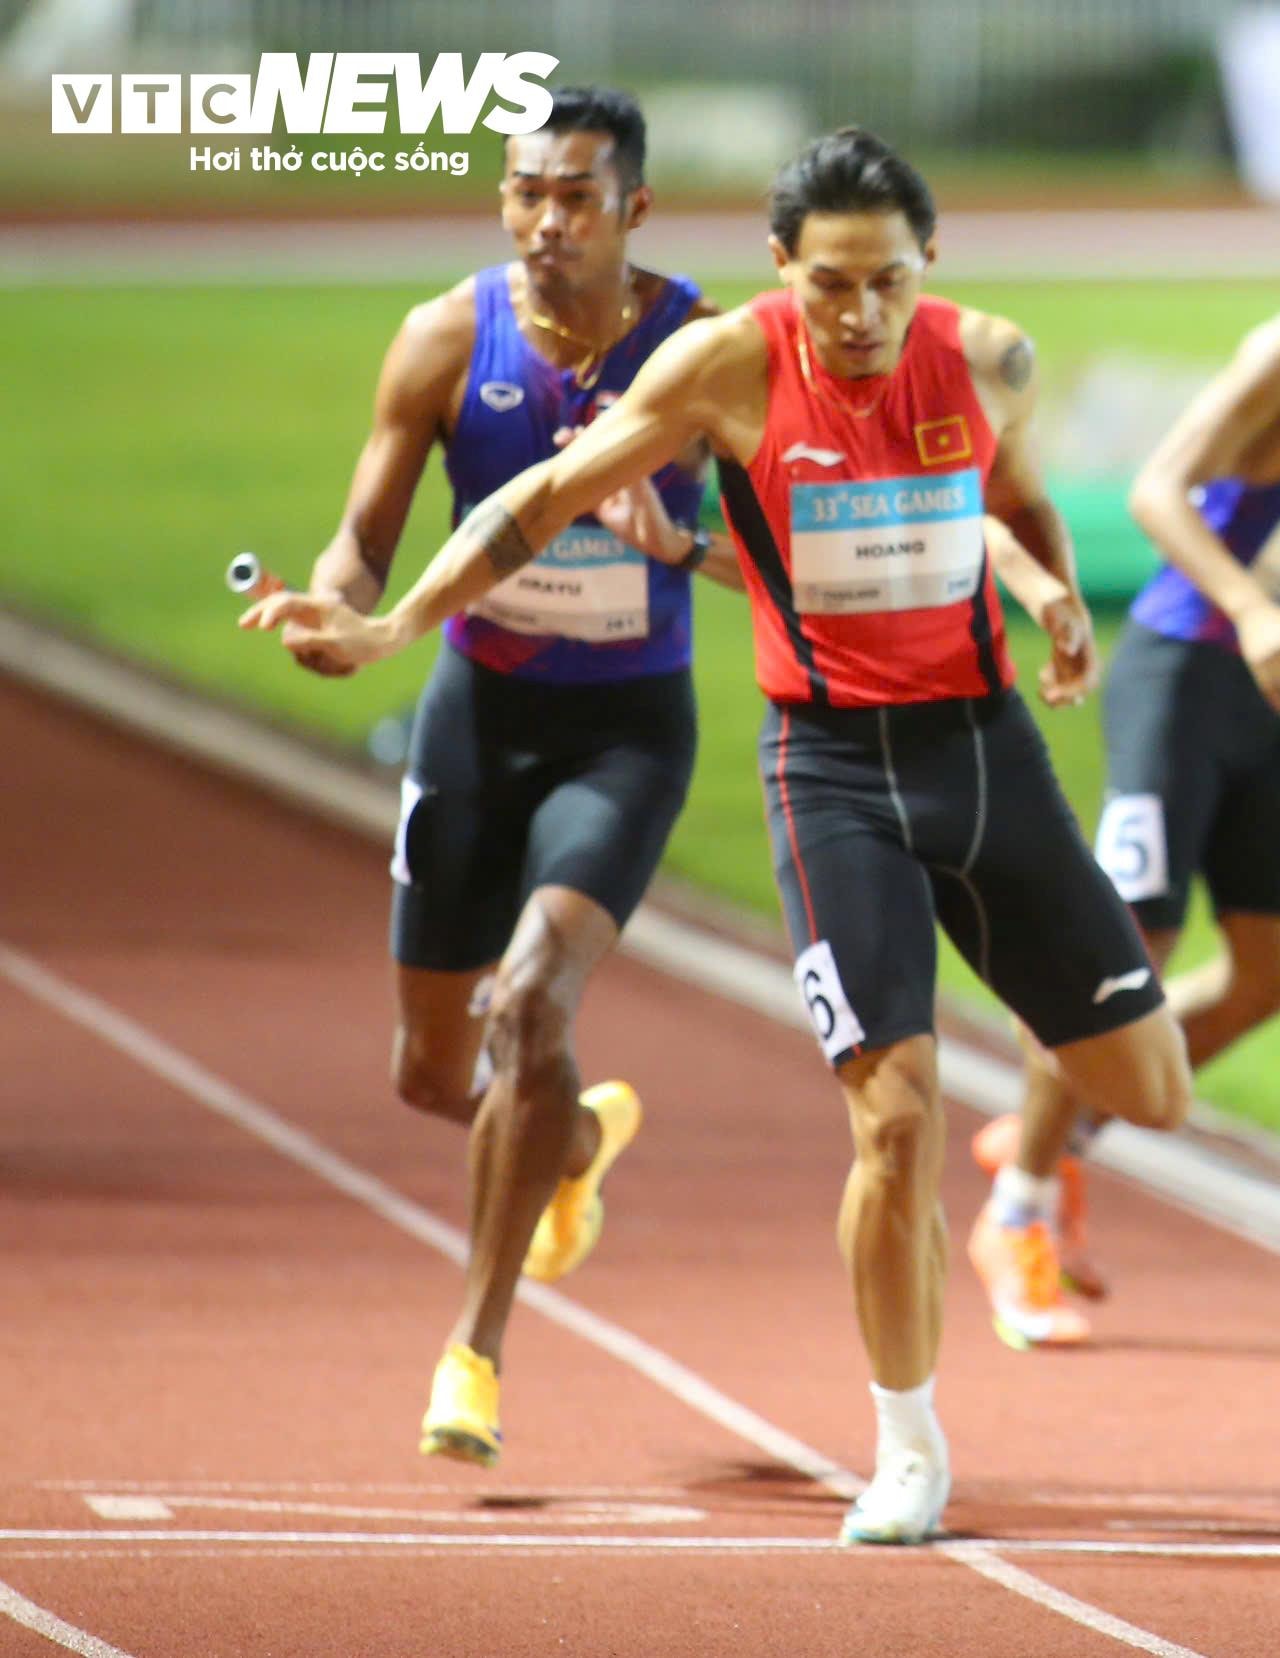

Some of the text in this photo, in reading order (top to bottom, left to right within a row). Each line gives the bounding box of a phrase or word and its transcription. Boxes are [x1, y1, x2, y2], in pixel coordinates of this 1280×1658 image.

[850, 494, 889, 519] SEA
[894, 487, 966, 516] GAMES
[855, 540, 926, 559] HOANG
[1115, 814, 1149, 882] 5
[804, 969, 836, 1041] 6
